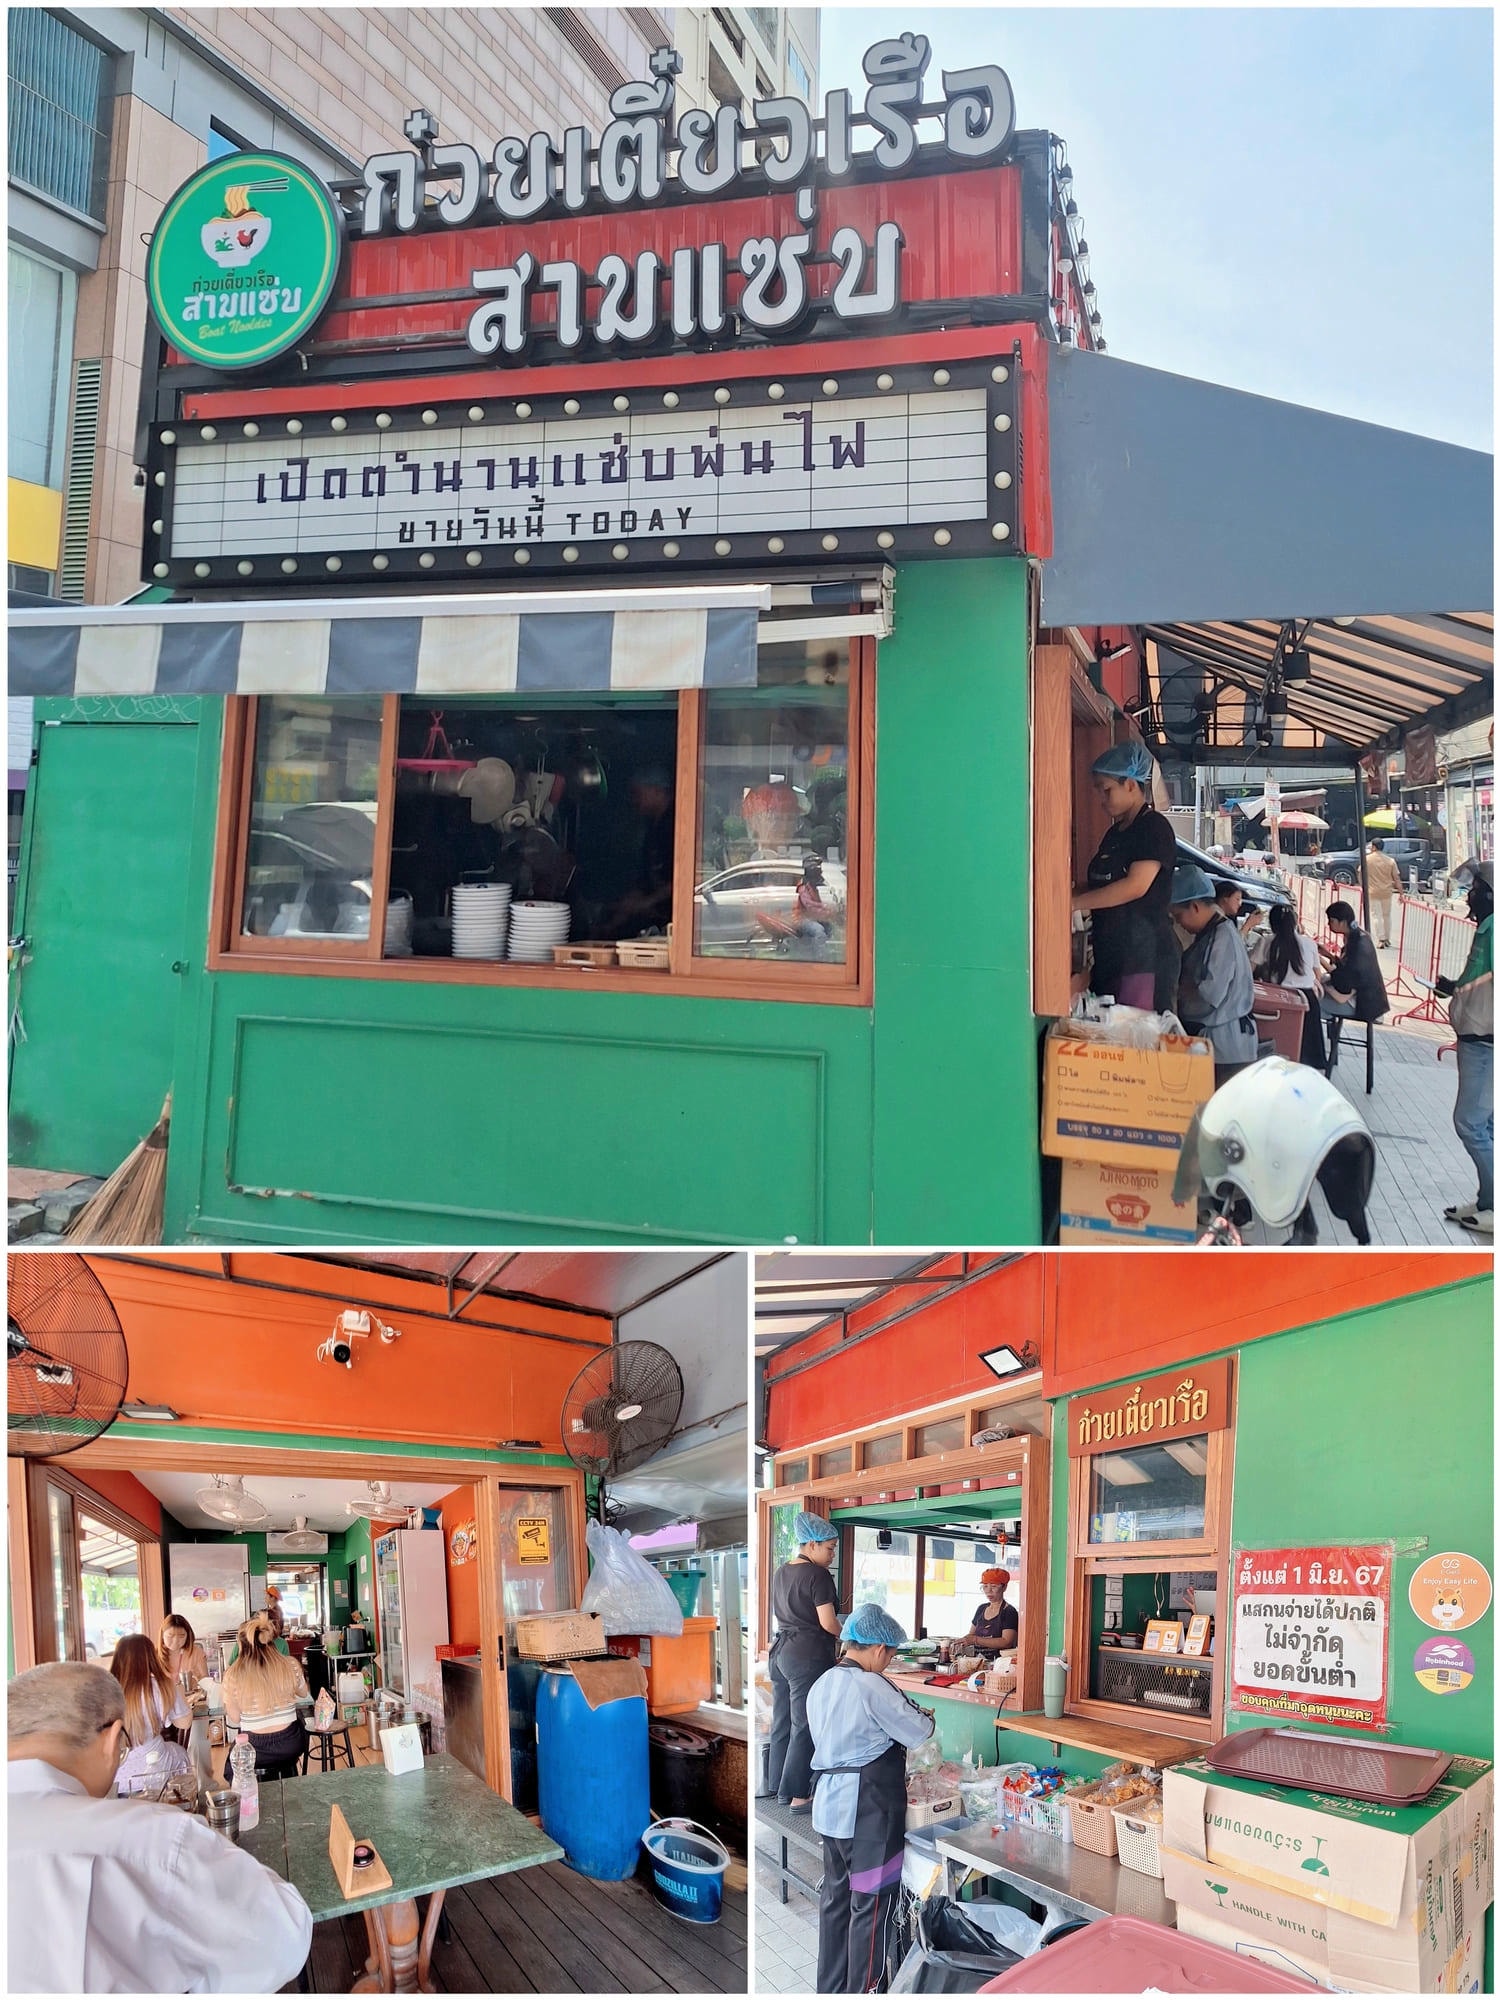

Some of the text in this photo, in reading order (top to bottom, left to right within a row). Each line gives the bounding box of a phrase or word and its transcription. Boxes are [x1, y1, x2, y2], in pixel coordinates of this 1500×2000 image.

[361, 32, 1016, 234] ก๋วยเตี๋ยวเรือ
[466, 187, 904, 355] สามแซ่บ
[182, 277, 302, 321] สามแซ่บ
[198, 324, 226, 340] Boat
[399, 495, 692, 543] ขายวันนี้ TODAY
[1240, 1558, 1385, 1586] ตั้งแต่ 1 มิ.ย. 67
[1423, 1577, 1478, 1586] Enjoy Easy Life
[1242, 1598, 1376, 1622] แสกนจ่ายได้ปกติ
[1265, 1623, 1344, 1653] ไม่จำกัด
[1253, 1650, 1357, 1688] ยอดขั้นต่ำ
[1425, 1656, 1464, 1667] Robinhood
[1241, 1692, 1372, 1722] ขอบคุณที่มาอุดหนุนนะคะ
[1204, 1811, 1302, 1850] ระวังของแตก
[1232, 1900, 1327, 1941] HANDLE WITH CA
